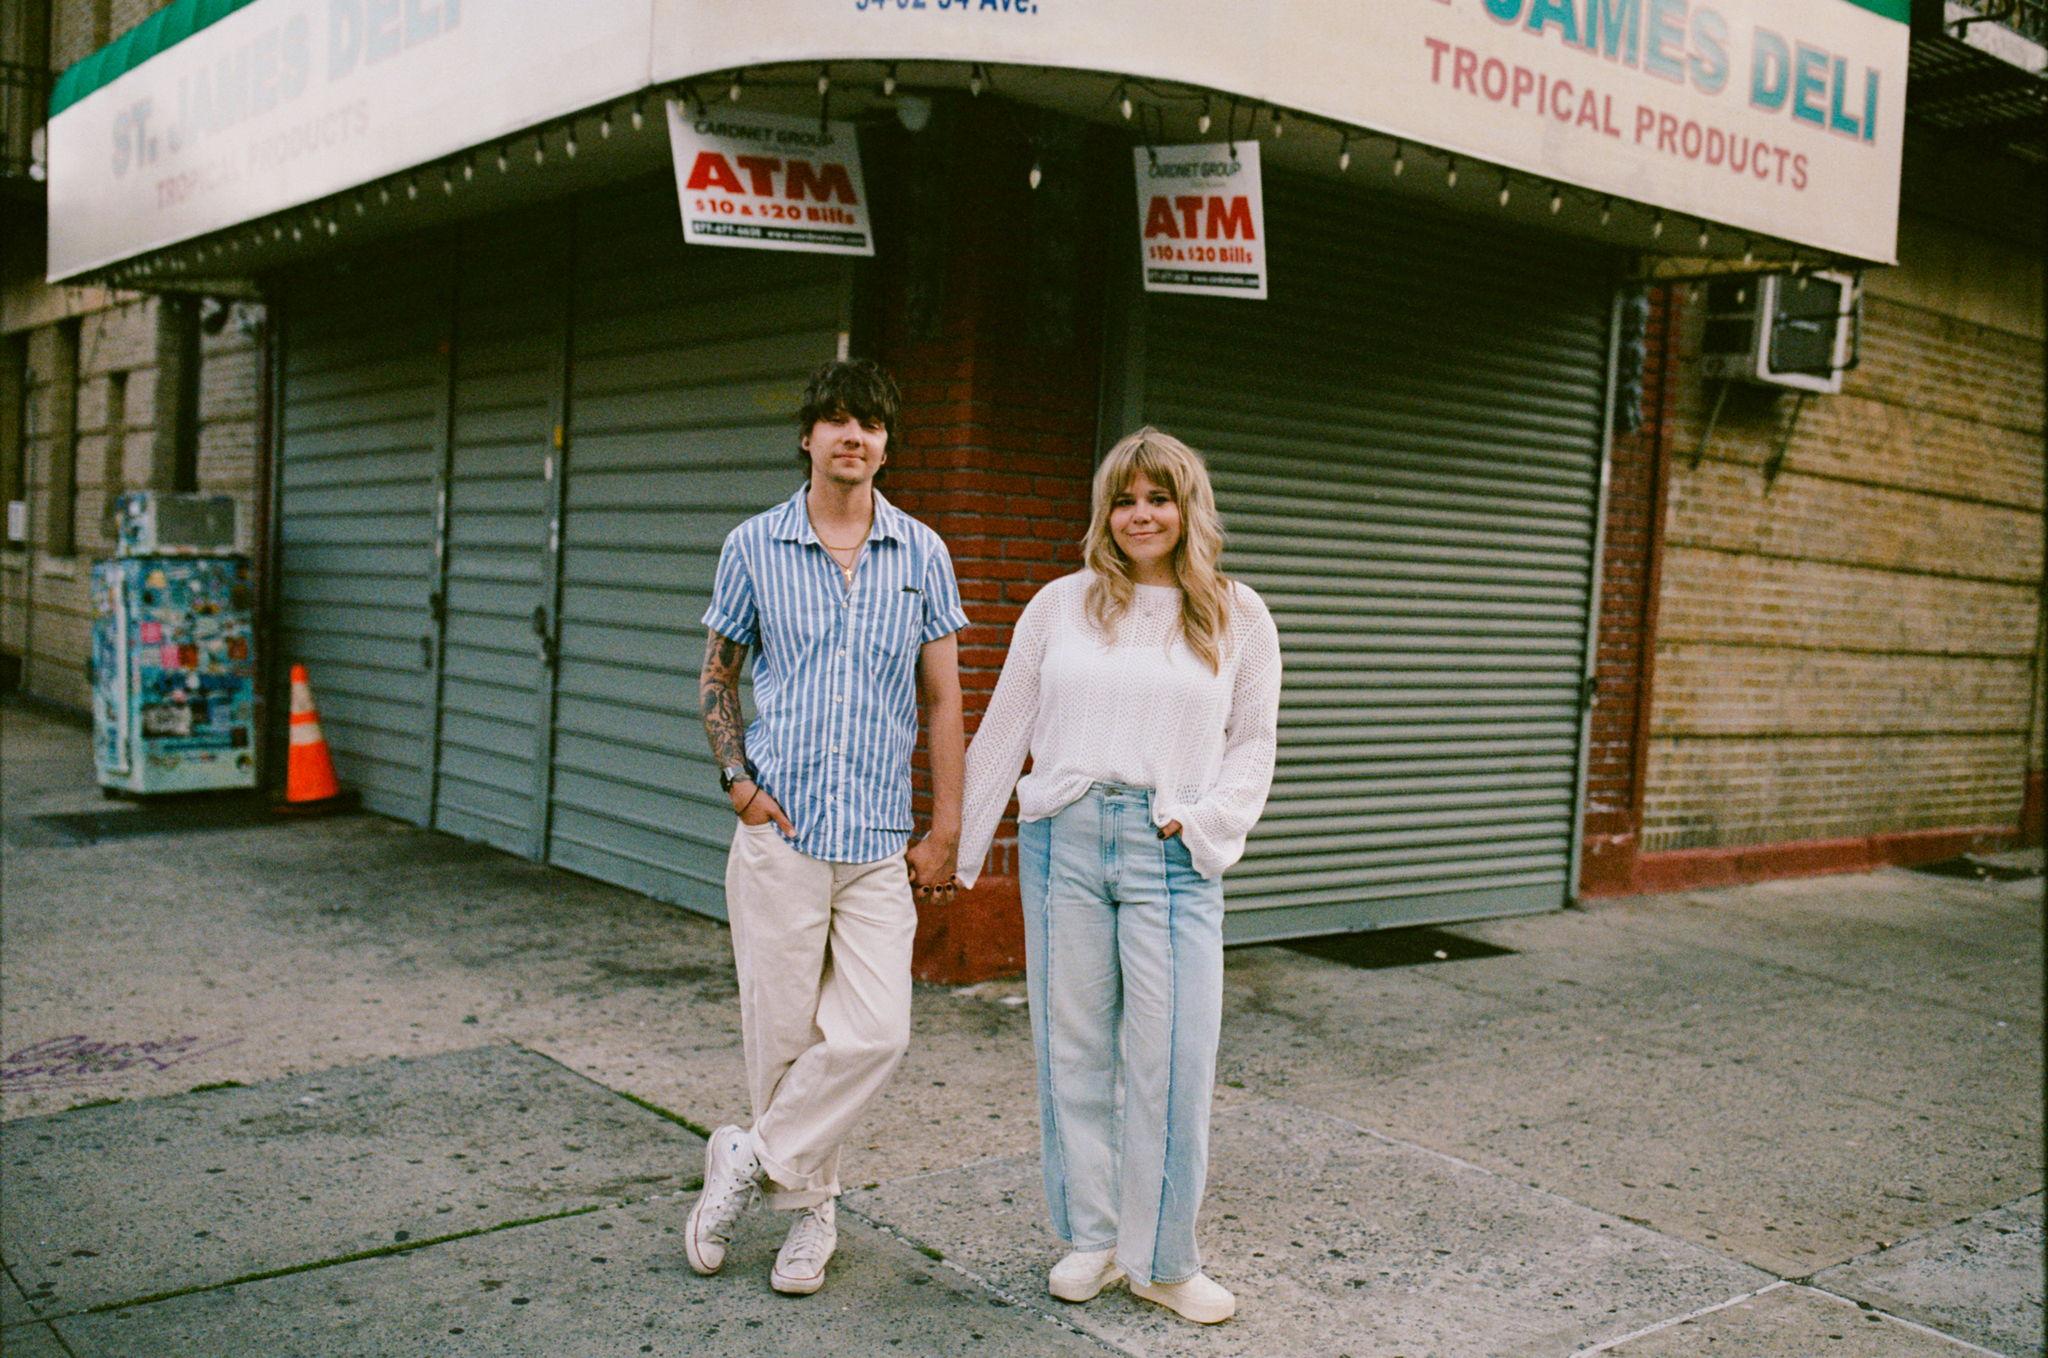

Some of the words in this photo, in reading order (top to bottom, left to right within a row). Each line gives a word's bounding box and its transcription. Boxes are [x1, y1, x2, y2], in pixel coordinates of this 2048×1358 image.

[1749, 25, 1881, 147] DELI
[1424, 37, 1621, 139] TROPICAL
[1634, 105, 1809, 191] PRODUCTS
[686, 150, 859, 206] ATM
[695, 198, 735, 215] $10
[759, 204, 801, 220] $20
[807, 206, 856, 225] Bills
[1144, 195, 1255, 240] ATM
[1151, 246, 1173, 260] $10
[1188, 247, 1216, 262] $20
[1219, 247, 1253, 264] Bills
